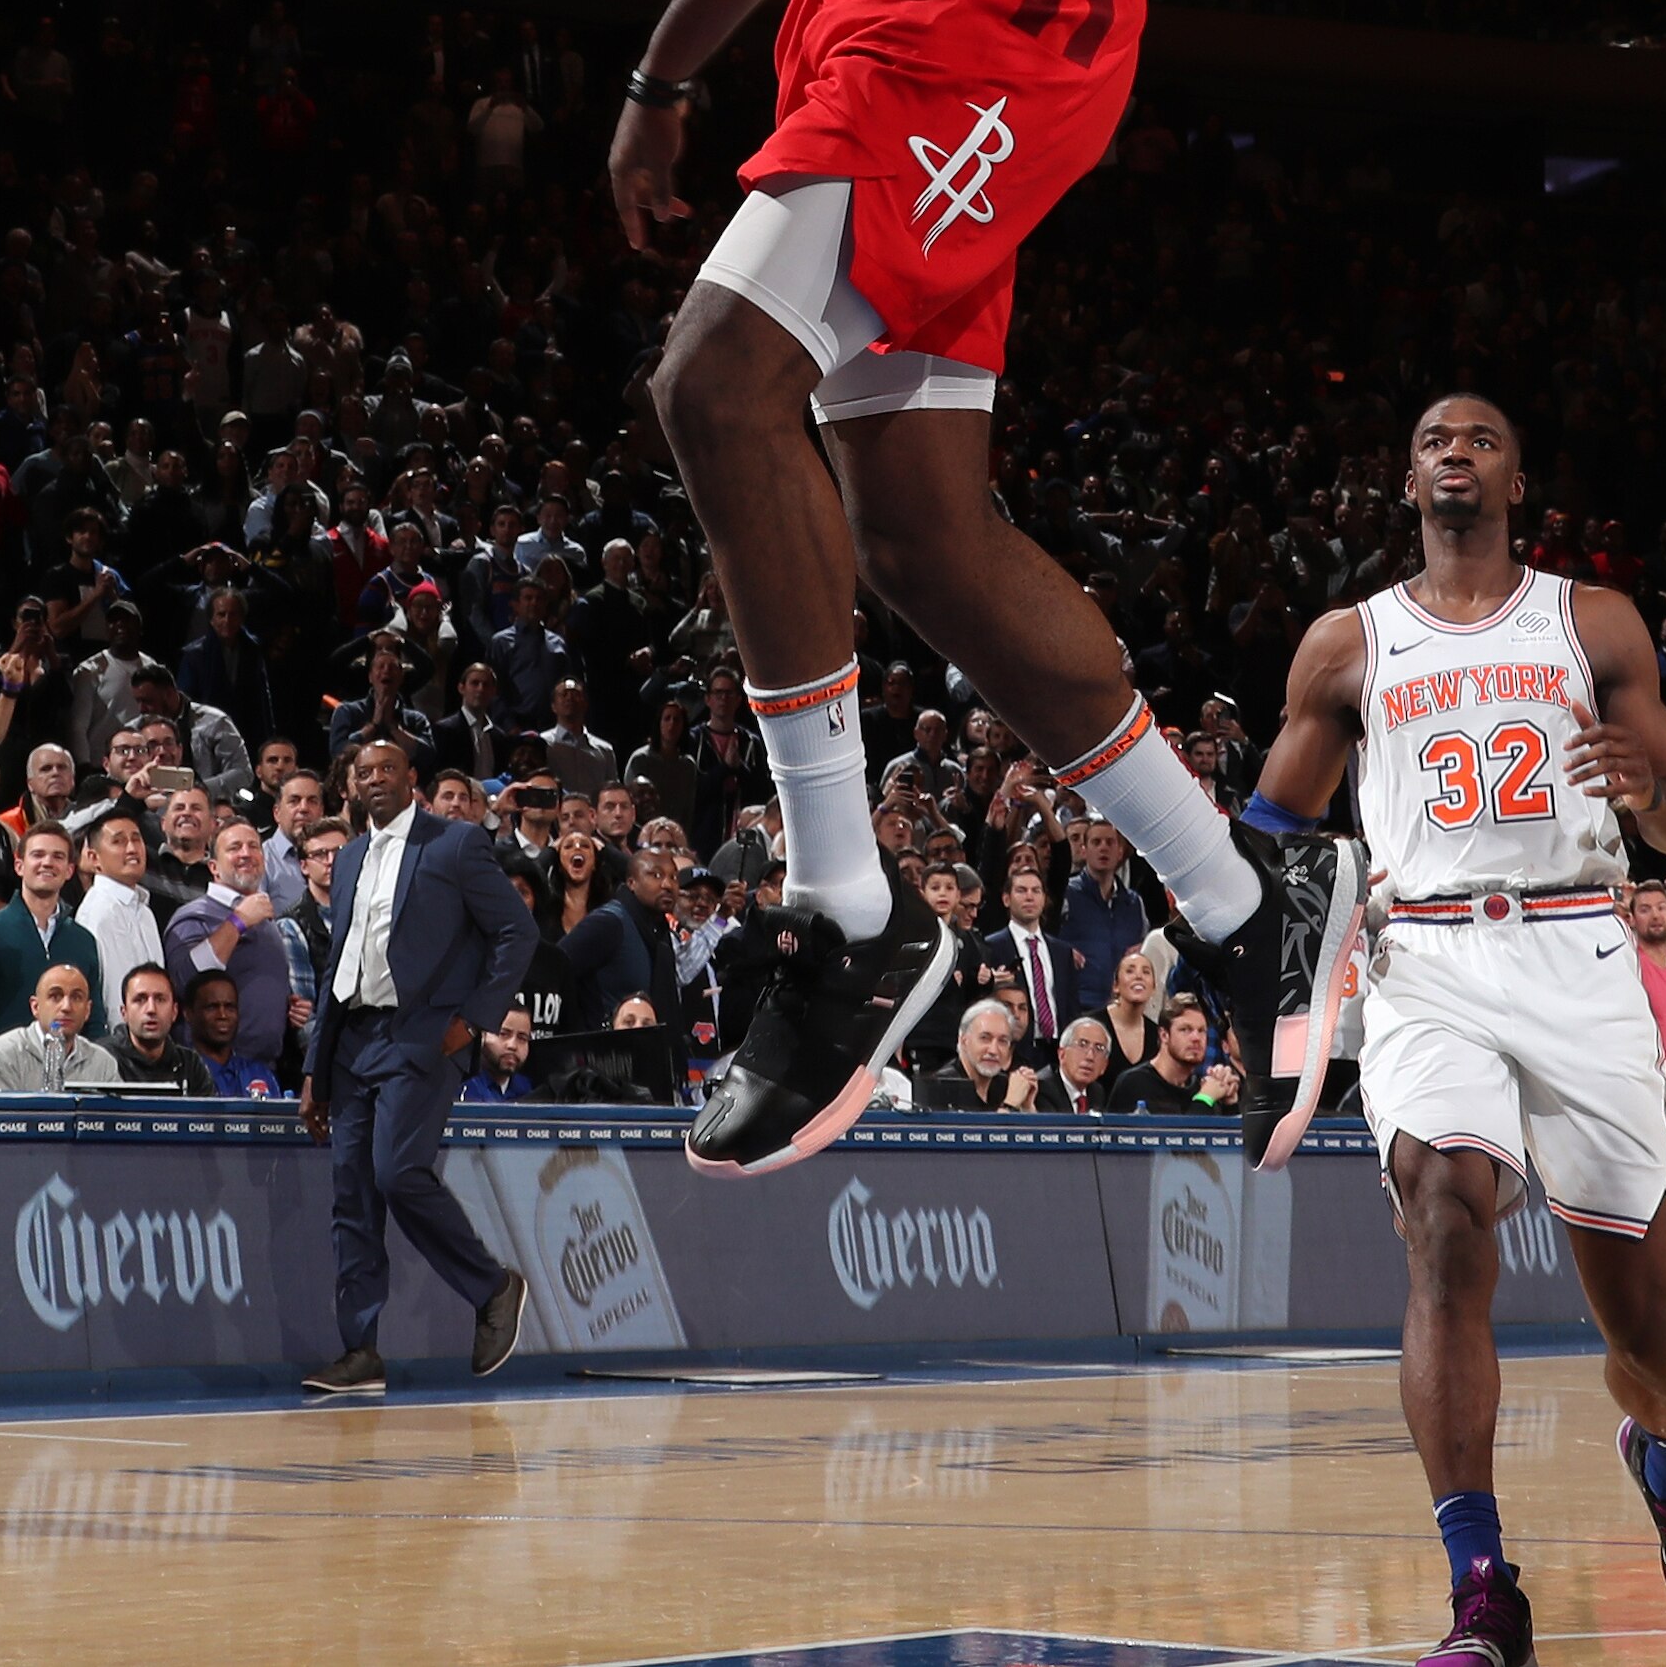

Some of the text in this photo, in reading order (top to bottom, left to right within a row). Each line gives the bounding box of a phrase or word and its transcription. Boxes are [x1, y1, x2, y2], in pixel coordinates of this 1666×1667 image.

[1380, 663, 1572, 733] NEW YORK
[1419, 720, 1557, 832] 32
[0, 1122, 27, 1133] CHASE
[37, 1122, 65, 1132] CHASE
[77, 1121, 105, 1131] CHASE
[115, 1122, 142, 1132] CHASE
[152, 1122, 178, 1132] CHASE
[188, 1122, 214, 1133] CHASE
[224, 1123, 250, 1133] CHASE
[259, 1124, 285, 1134] CHASE
[462, 1128, 486, 1138] CHASE
[494, 1128, 518, 1138] CHASE
[526, 1129, 550, 1139] CHASE
[558, 1129, 581, 1139] CHASE
[589, 1129, 612, 1139] CHASE
[619, 1129, 643, 1139] CHASE
[650, 1129, 673, 1139] CHASE
[15, 1171, 245, 1332] Cuervo
[560, 1222, 639, 1308] Cuervo
[828, 1176, 1000, 1311] Cuervo
[1162, 1200, 1224, 1276] Cuervo
[588, 1286, 651, 1342] ESPECIAL
[1165, 1264, 1221, 1313] ESPECIAL
